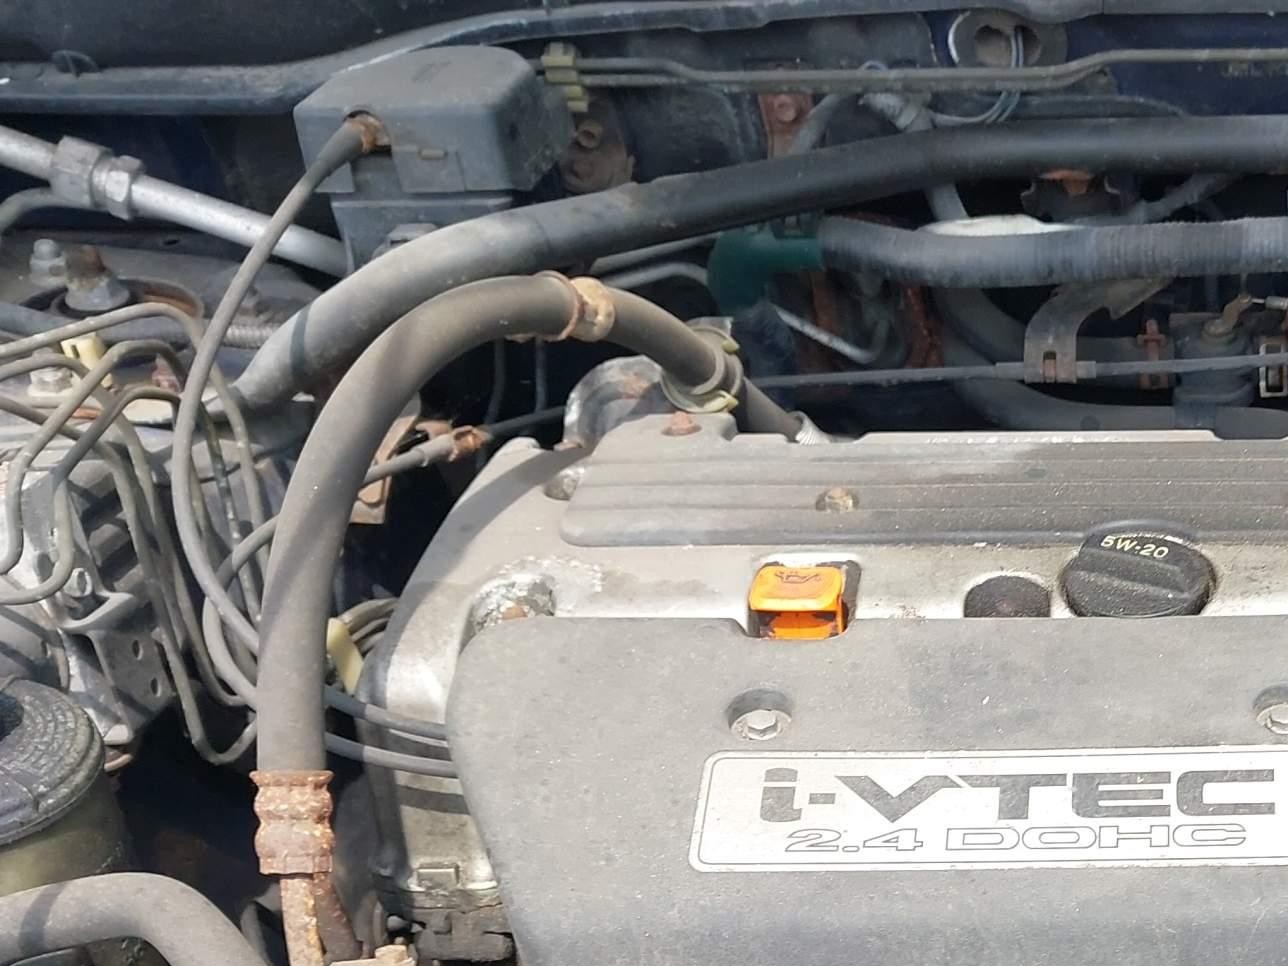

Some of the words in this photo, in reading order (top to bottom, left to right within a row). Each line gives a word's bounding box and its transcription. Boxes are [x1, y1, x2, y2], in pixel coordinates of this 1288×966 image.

[759, 767, 1275, 824] i-VTEC
[785, 828, 924, 853] 2.4
[945, 823, 1248, 851] DOHC
